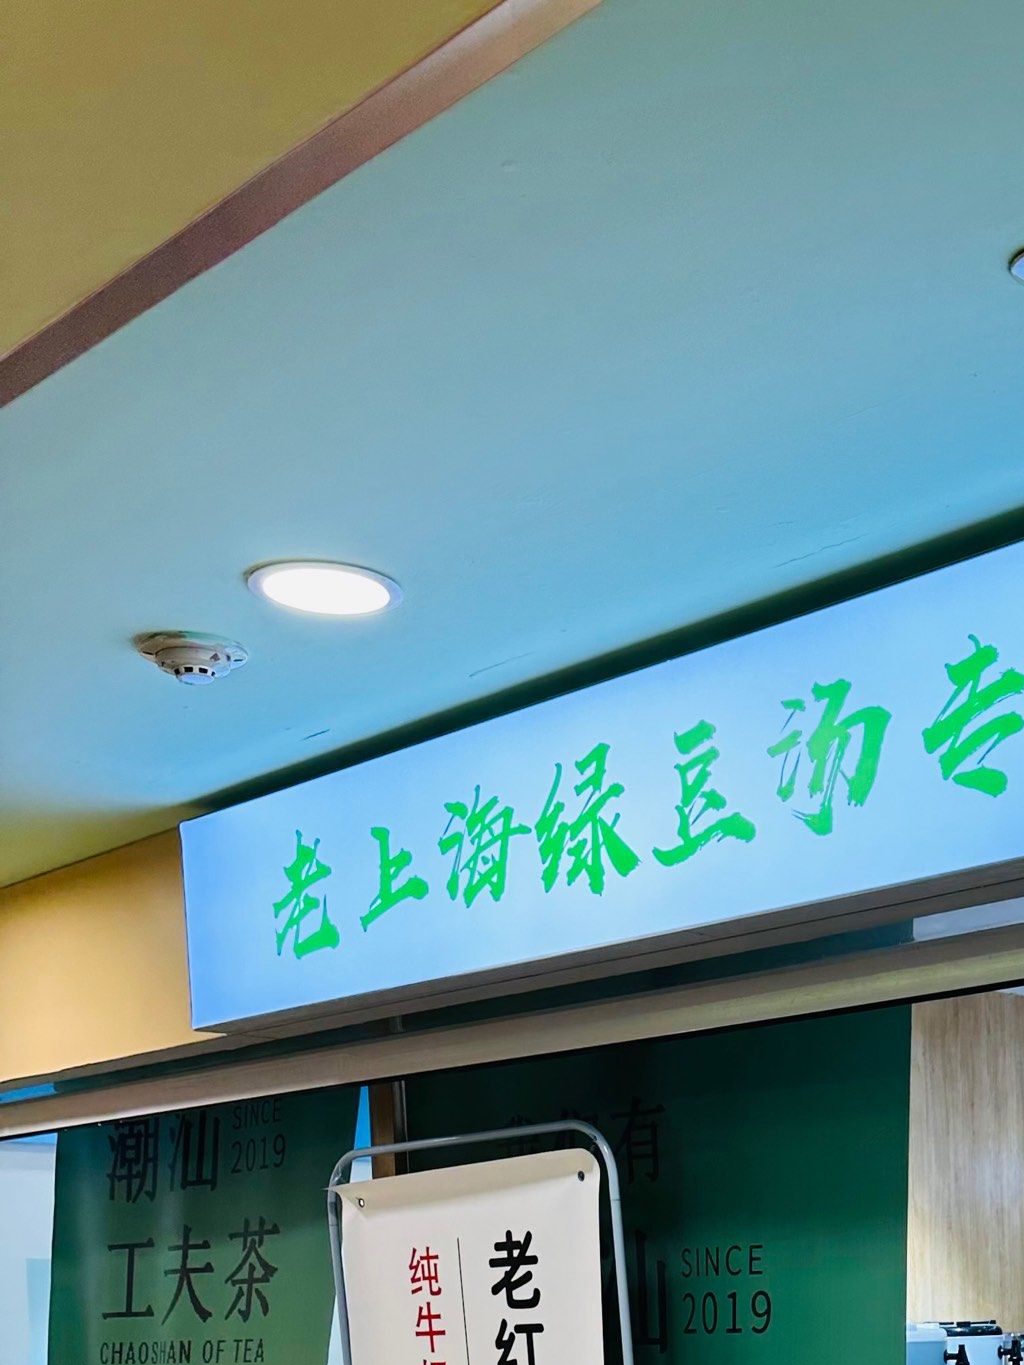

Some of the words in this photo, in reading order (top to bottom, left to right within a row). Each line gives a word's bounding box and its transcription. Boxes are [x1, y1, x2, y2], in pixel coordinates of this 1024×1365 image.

[231, 1097, 283, 1131] SINCE
[230, 1133, 287, 1175] 2019
[101, 1215, 281, 1326] 工夫茶
[680, 1243, 764, 1279] SINCE
[682, 1289, 772, 1335] 2019
[99, 1339, 192, 1365] CHAOSHAN
[202, 1339, 226, 1364] OF
[232, 1338, 265, 1364] TEA
